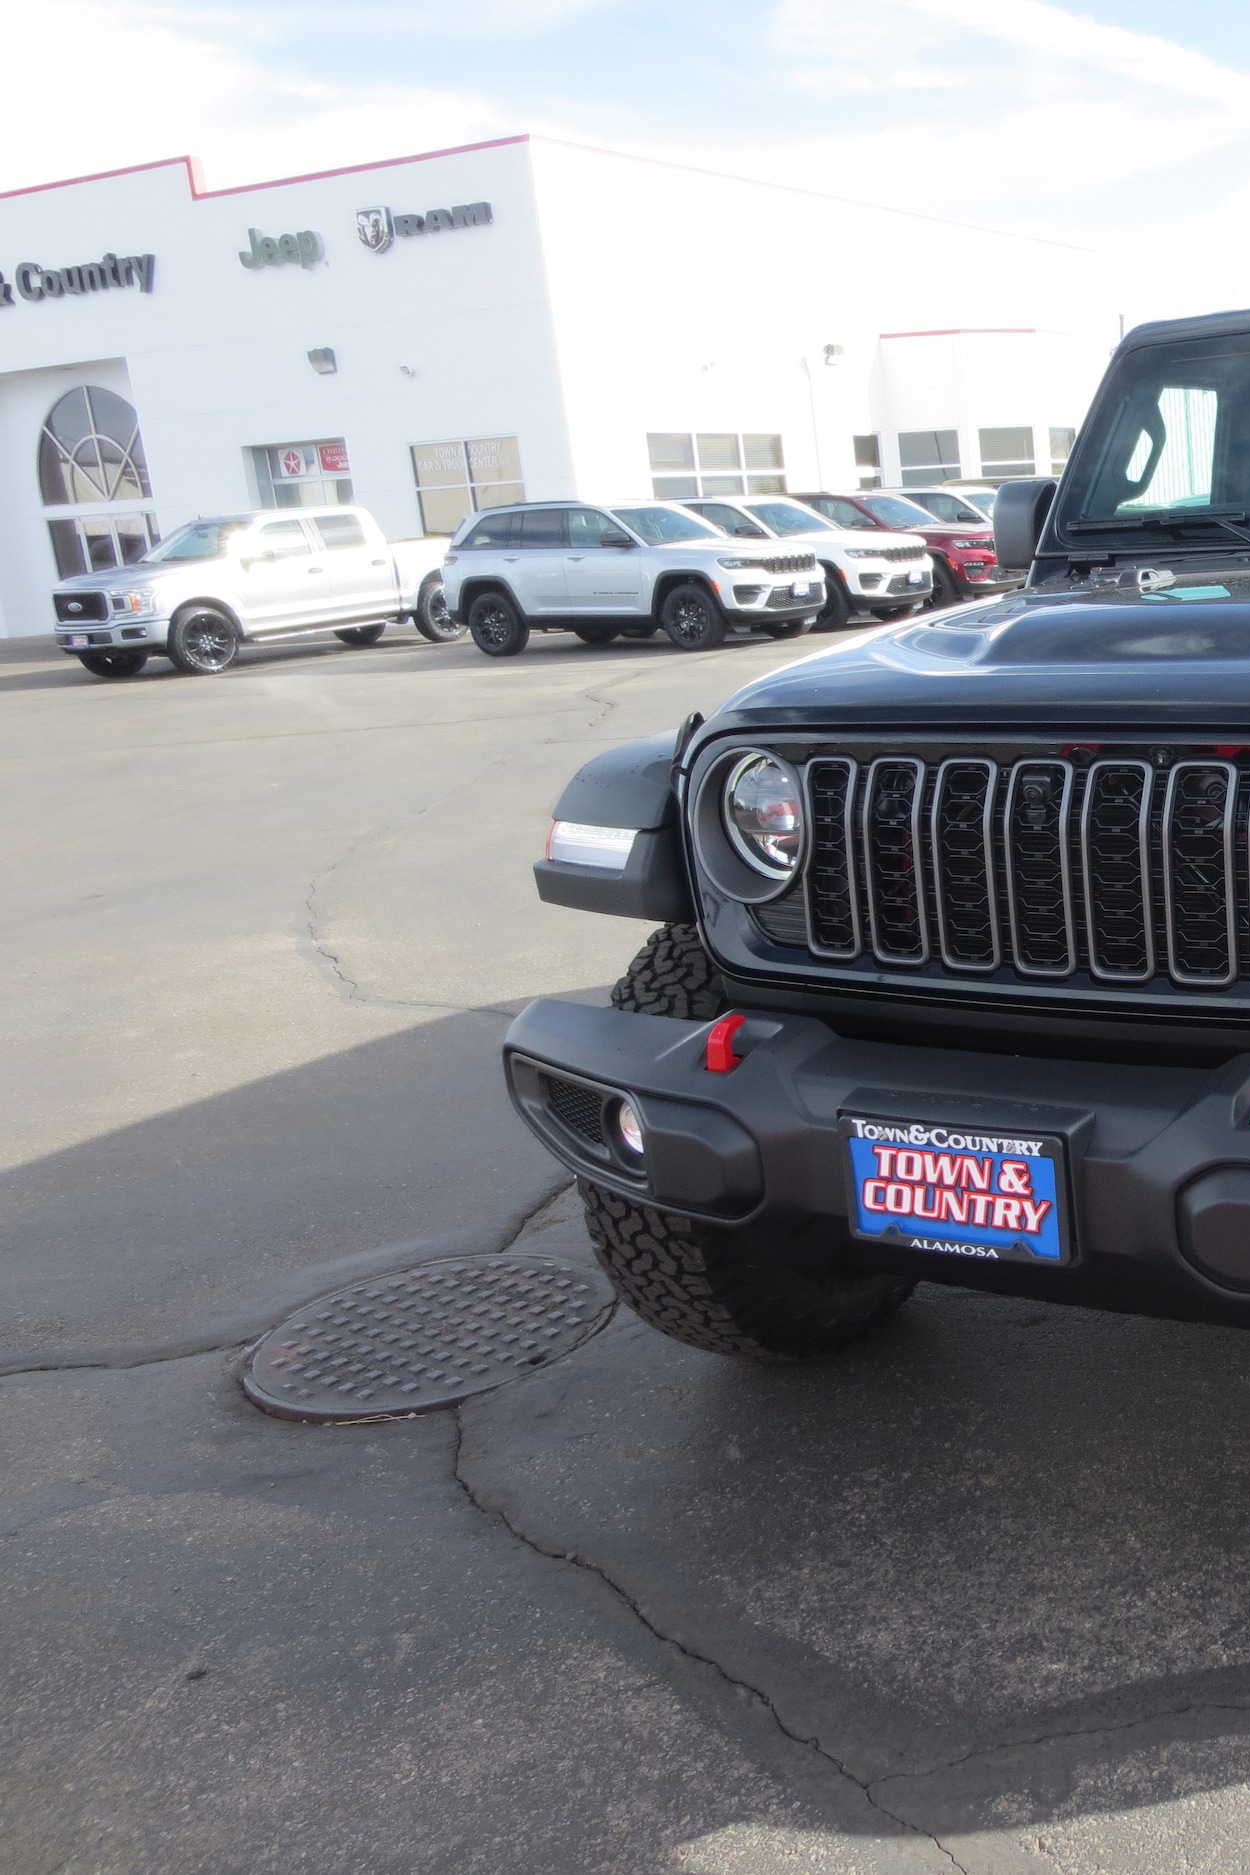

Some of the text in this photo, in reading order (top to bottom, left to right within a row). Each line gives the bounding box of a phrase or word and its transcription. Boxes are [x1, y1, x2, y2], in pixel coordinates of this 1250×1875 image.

[394, 201, 493, 238] RAM
[238, 228, 325, 270] Jeep
[15, 252, 156, 301] Country
[420, 460, 434, 472] CAR
[434, 446, 457, 458] TOWN
[872, 1144, 1033, 1196] TOWN &
[862, 1178, 1051, 1233] COUNTRY
[910, 1238, 1000, 1259] ALAMOSA
